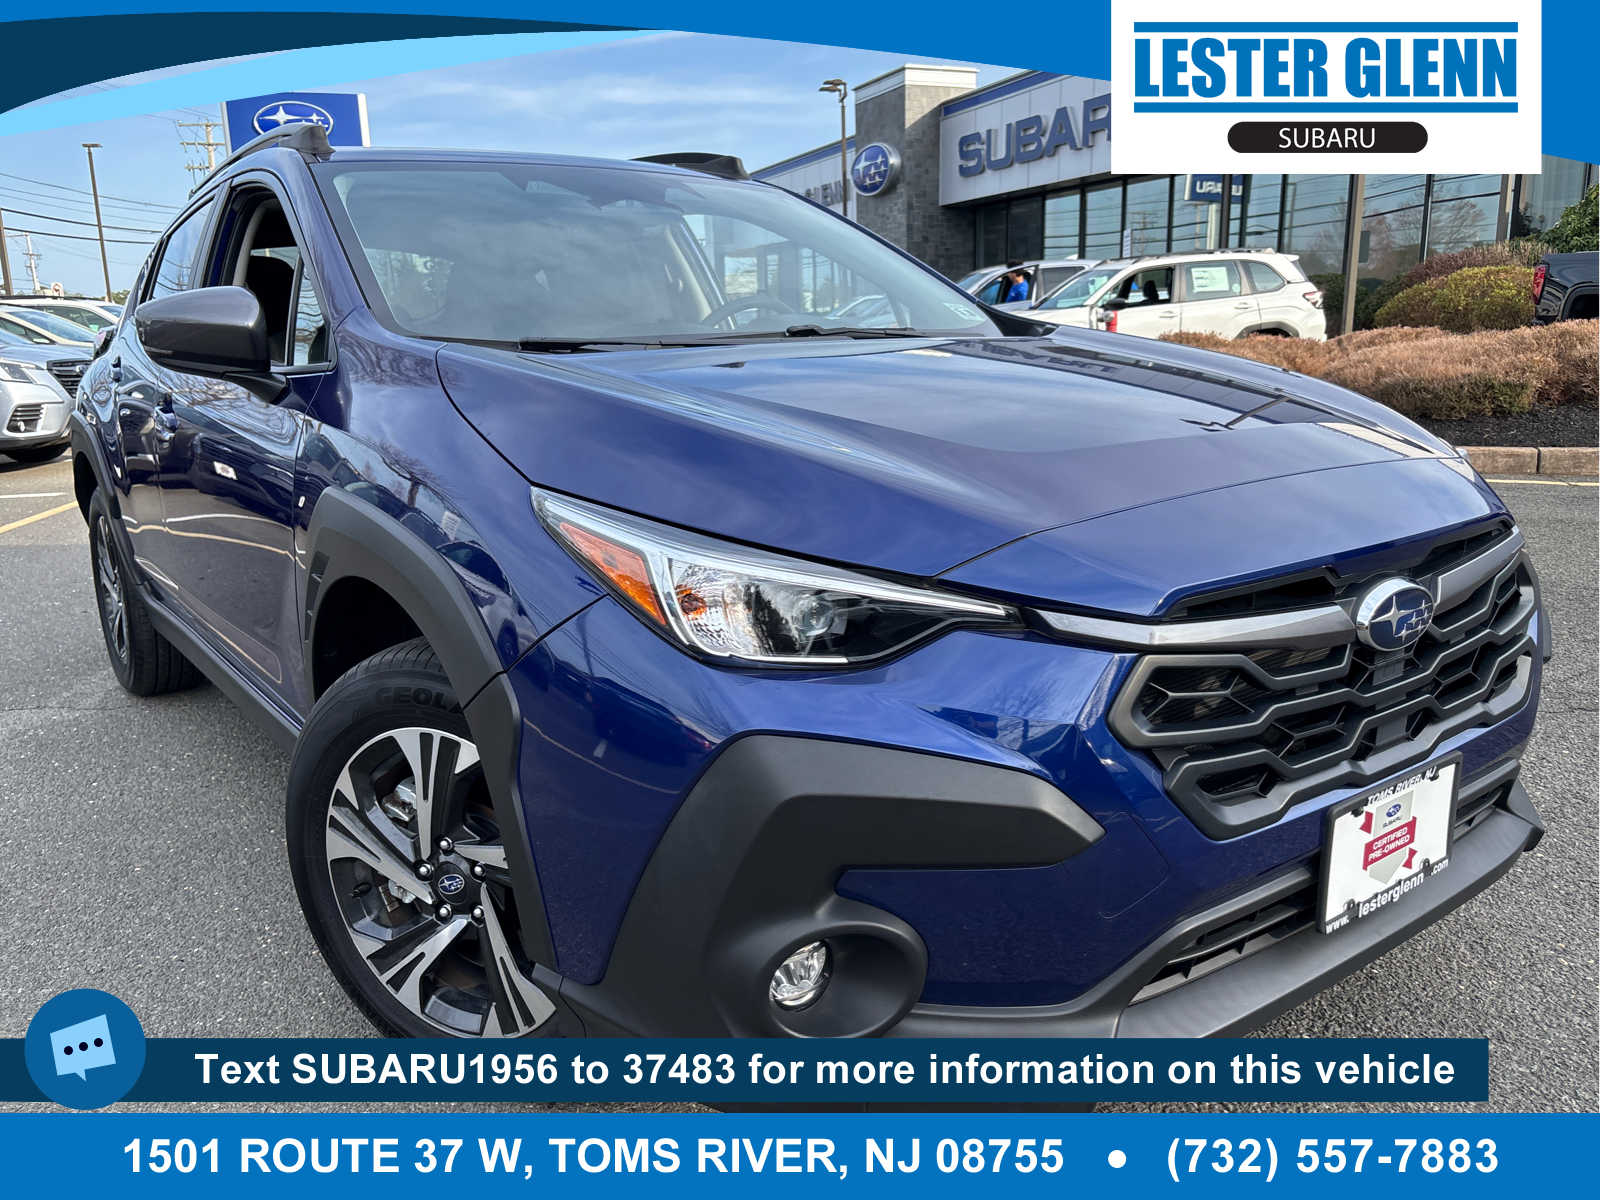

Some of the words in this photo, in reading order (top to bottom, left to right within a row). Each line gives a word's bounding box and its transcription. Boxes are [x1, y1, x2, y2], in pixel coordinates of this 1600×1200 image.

[1367, 787, 1395, 805] TOMS
[1424, 766, 1438, 782] NJ
[1368, 835, 1410, 862] PRE-OWNED
[1372, 827, 1408, 850] CERTIFIED
[1358, 872, 1424, 918] lesterglenn
